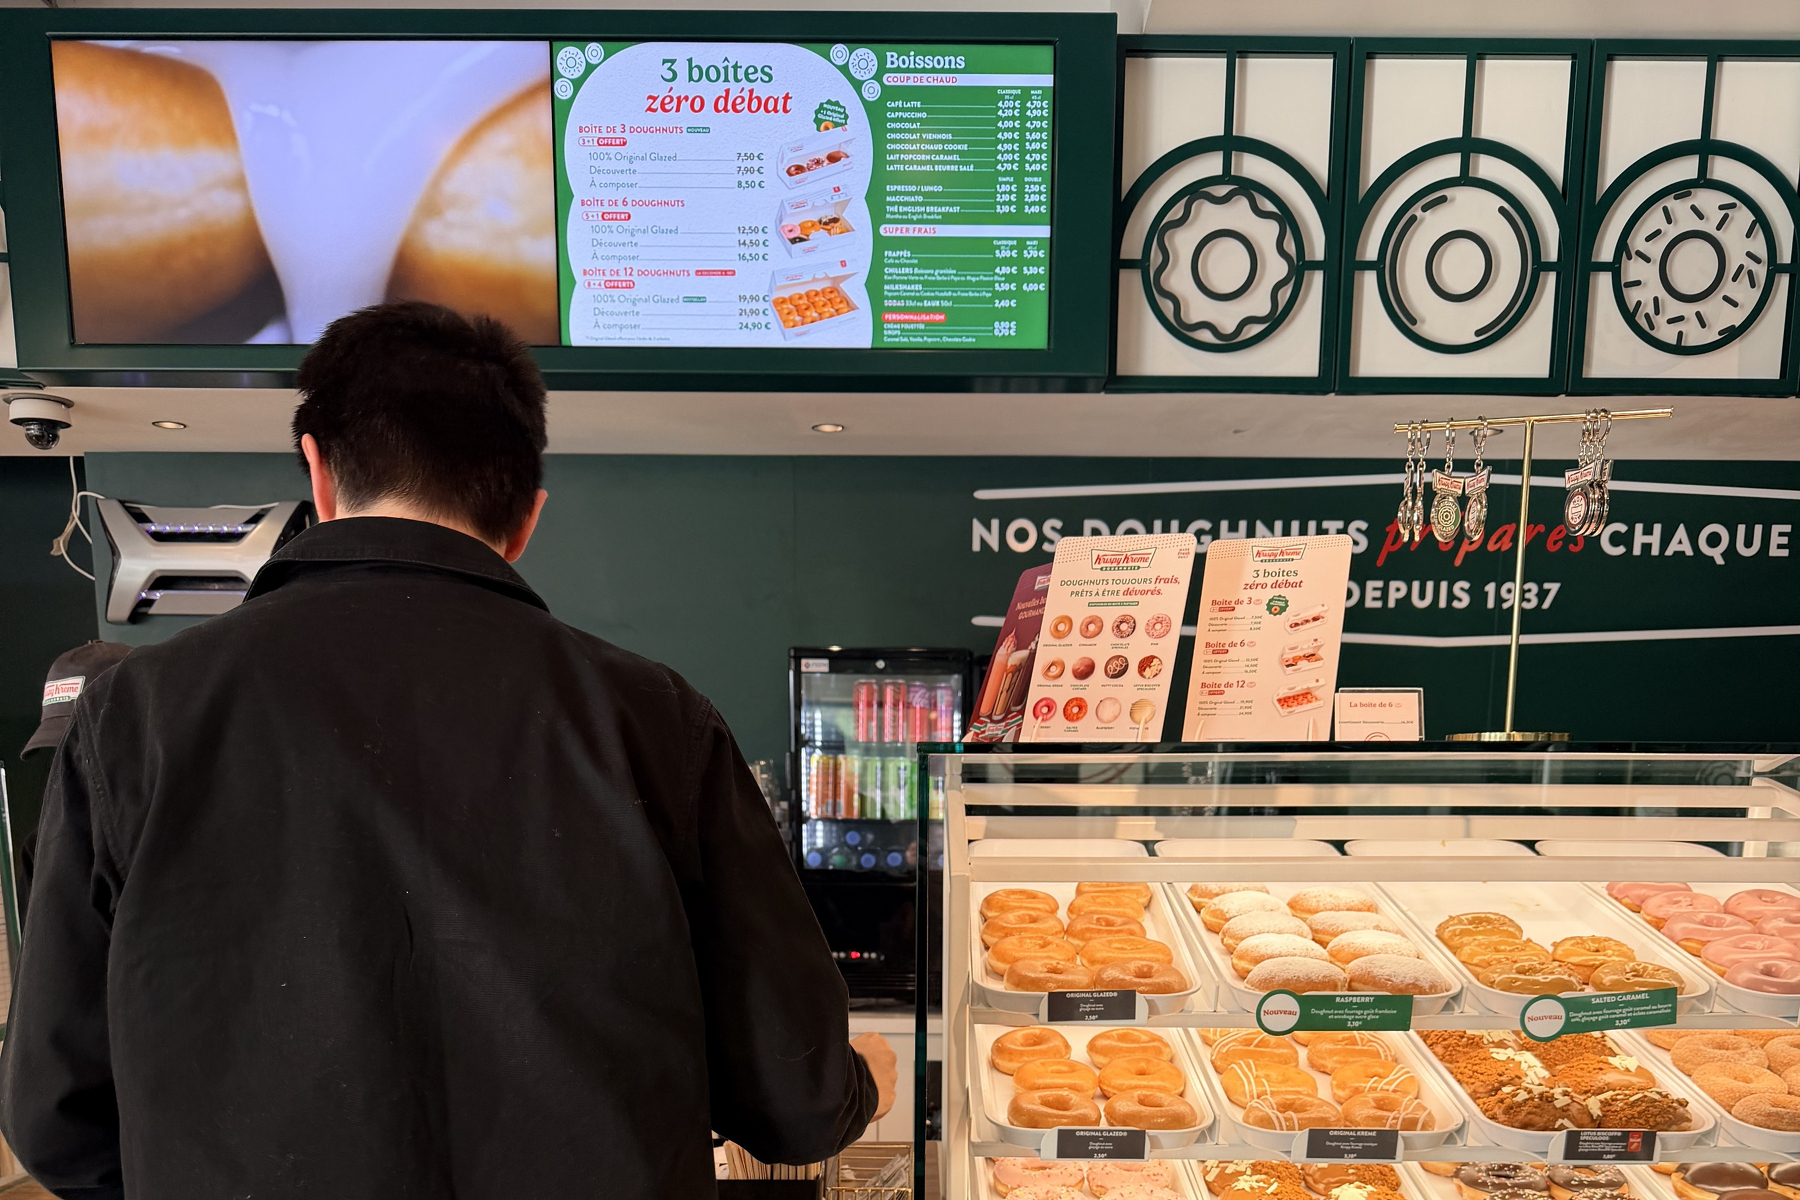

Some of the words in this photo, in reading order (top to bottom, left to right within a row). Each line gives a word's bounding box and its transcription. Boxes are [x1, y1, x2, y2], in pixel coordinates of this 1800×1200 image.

[886, 51, 965, 69] Boissons
[660, 58, 678, 83] 3
[686, 56, 773, 83] boîtes
[886, 76, 911, 84] COUP
[913, 76, 924, 84] DE
[926, 76, 958, 84] CHAUD
[644, 86, 706, 114] zéro
[713, 87, 793, 114] débat
[886, 100, 903, 108] CAFÉ
[997, 101, 1014, 109] 4,00
[1026, 101, 1042, 109] 4,70
[997, 109, 1013, 117] 4,20
[1025, 110, 1041, 118] 4,90
[578, 124, 603, 134] BOÎTE
[605, 126, 617, 134] DE
[620, 123, 626, 134] 3
[629, 125, 684, 134] DOUGHNUTS
[997, 120, 1013, 128] 4,00
[1025, 121, 1041, 129] 4,70
[997, 132, 1012, 140] 4,90
[1025, 132, 1041, 140] 5,60
[997, 143, 1013, 151] 4,90
[1025, 142, 1041, 150] 5,60
[589, 152, 612, 161] 100%
[614, 152, 647, 164] Original
[649, 152, 677, 161] Glazed
[736, 152, 755, 162] 7,50
[997, 153, 1013, 161] 4,00
[1025, 153, 1041, 161] 4,70
[589, 165, 637, 175] Découverte
[736, 166, 755, 176] 7,90
[996, 163, 1012, 171] 4,70
[1024, 163, 1040, 172] 5,40
[589, 177, 597, 188] À
[598, 182, 638, 191] composer
[737, 180, 756, 190] 8,50
[580, 197, 605, 207] BOÎTE
[608, 199, 619, 207] DE
[621, 196, 629, 207] 6
[631, 199, 685, 208] DOUGHNUTS
[590, 225, 614, 234] 100%
[616, 225, 649, 237] Original
[650, 225, 678, 235] Glazed
[737, 226, 759, 235] 12,50
[591, 238, 639, 248] Découverte
[738, 239, 760, 248] 14,50
[591, 251, 599, 261] À
[601, 254, 640, 263] composer
[738, 253, 760, 263] 16,50
[582, 267, 606, 277] BOÎTE
[610, 269, 620, 277] DE
[623, 266, 634, 277] 12
[637, 269, 690, 277] DOUGHNUTS
[592, 294, 616, 304] 100%
[617, 294, 651, 306] Original
[652, 294, 680, 304] Glazed
[738, 294, 760, 304] 19,90
[593, 308, 640, 317] Découverte
[738, 308, 760, 318] 21,90
[593, 320, 601, 330] À
[602, 322, 641, 332] composer
[738, 321, 763, 331] 24,90
[971, 518, 1062, 553] NOS
[1600, 522, 1791, 565] CHAQUE
[1094, 553, 1124, 566] Krispy
[1122, 552, 1151, 564] Kreme
[1255, 549, 1280, 559] Krispy
[1279, 548, 1303, 557] Kreme
[1252, 569, 1260, 578] 3
[1060, 578, 1110, 586] DOUGHNUTS
[1111, 577, 1152, 586] TOUJOURS
[1154, 575, 1180, 586] frais,
[1243, 580, 1268, 590] zéro
[1270, 578, 1303, 589] débat
[1070, 589, 1093, 597] PRÊTS
[1094, 589, 1100, 597] À
[1102, 588, 1120, 597] ÊTRE
[1122, 587, 1163, 597] dévorés.
[1345, 580, 1471, 609] DEPUIS
[1484, 582, 1562, 610] 1937
[1246, 597, 1252, 605] 3
[1228, 640, 1238, 648] de
[1239, 639, 1246, 648] 6
[1223, 680, 1234, 688] de
[1236, 679, 1246, 688] 12
[1591, 996, 1616, 1004] SALTED
[1617, 993, 1650, 1002] CARAMEL
[1263, 1009, 1298, 1017] Nouveau
[1527, 1014, 1563, 1023] Nouveau
